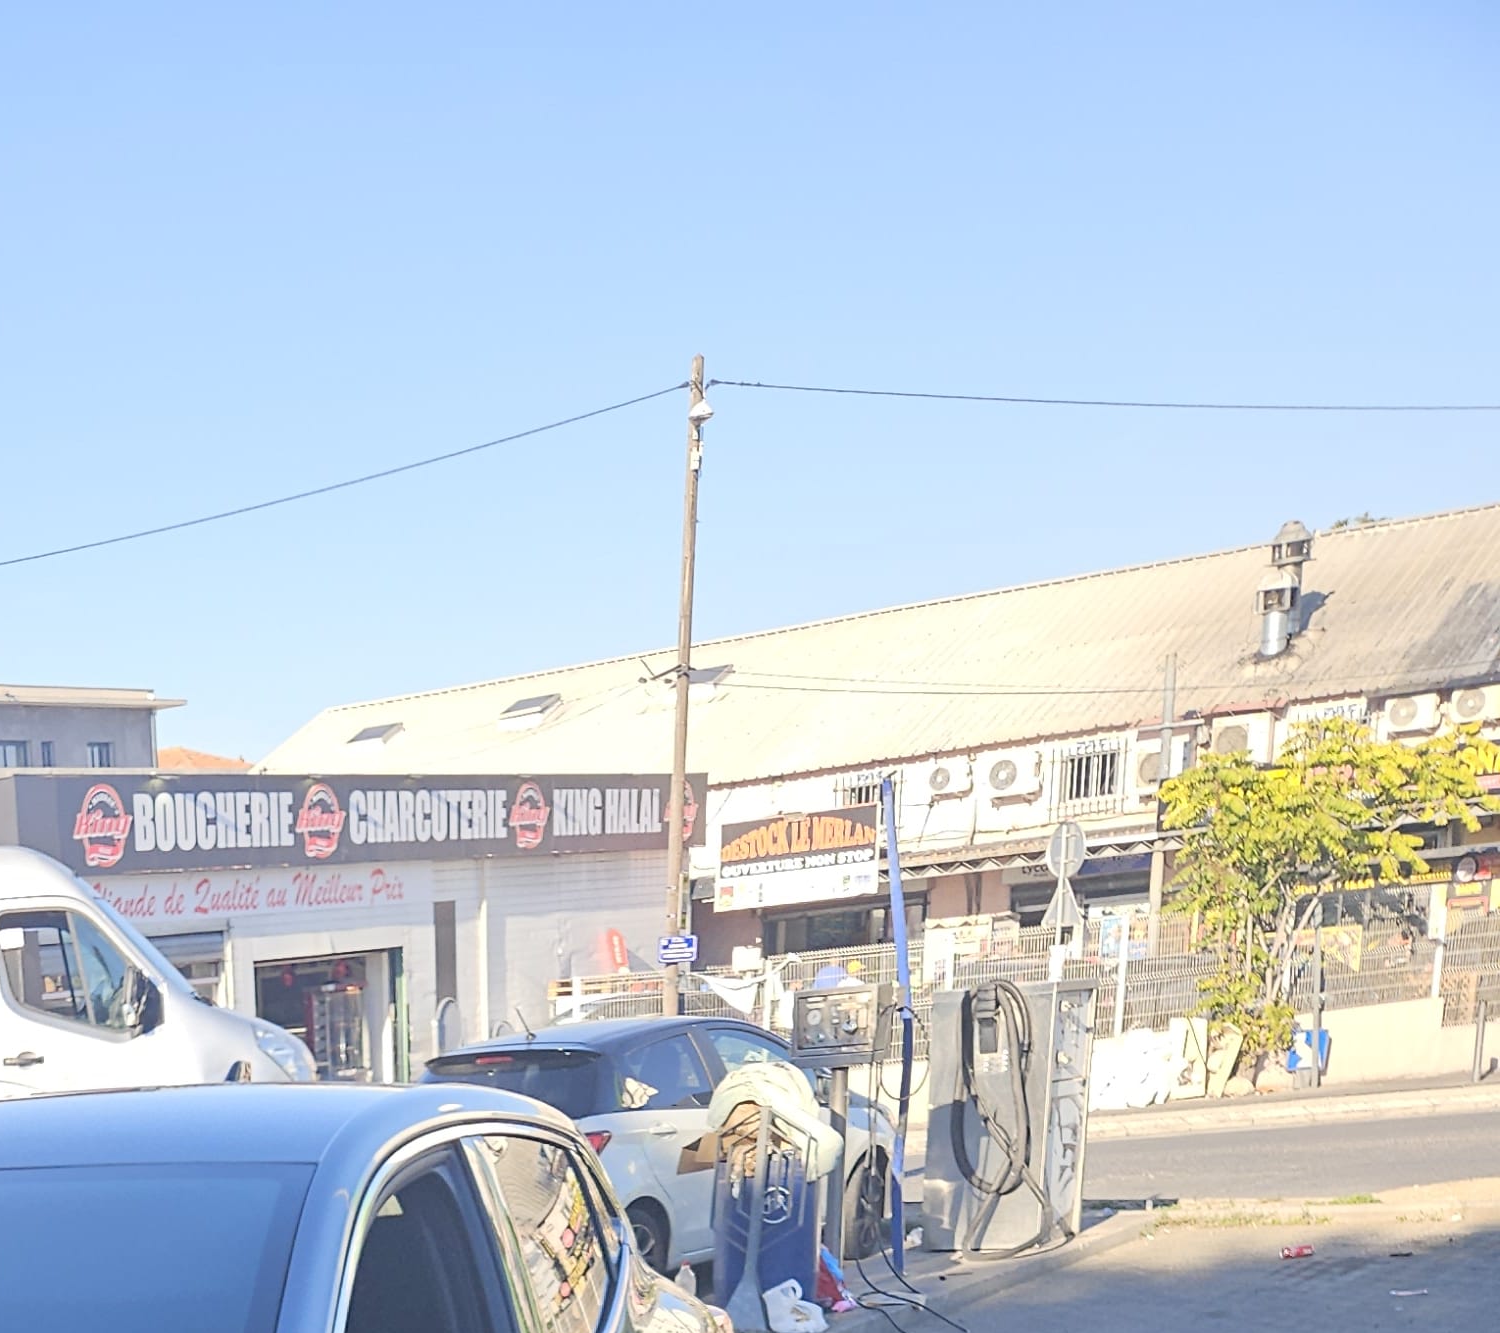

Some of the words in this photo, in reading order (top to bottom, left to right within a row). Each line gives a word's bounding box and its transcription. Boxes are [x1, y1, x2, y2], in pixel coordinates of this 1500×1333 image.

[133, 791, 295, 851] BOUCHERIE
[349, 789, 508, 845] CHARCUTERIE
[553, 788, 604, 836] KING
[605, 788, 662, 834] HALAL
[721, 818, 789, 863] DESTOCK
[791, 816, 811, 853] LE
[811, 816, 876, 851] MERLAN
[804, 852, 836, 869] NON
[837, 849, 874, 864] STOP
[164, 876, 185, 915] de
[194, 876, 260, 915] Qualité
[267, 886, 288, 907] au
[292, 868, 364, 908] Meilleur
[368, 866, 405, 906] Prix
